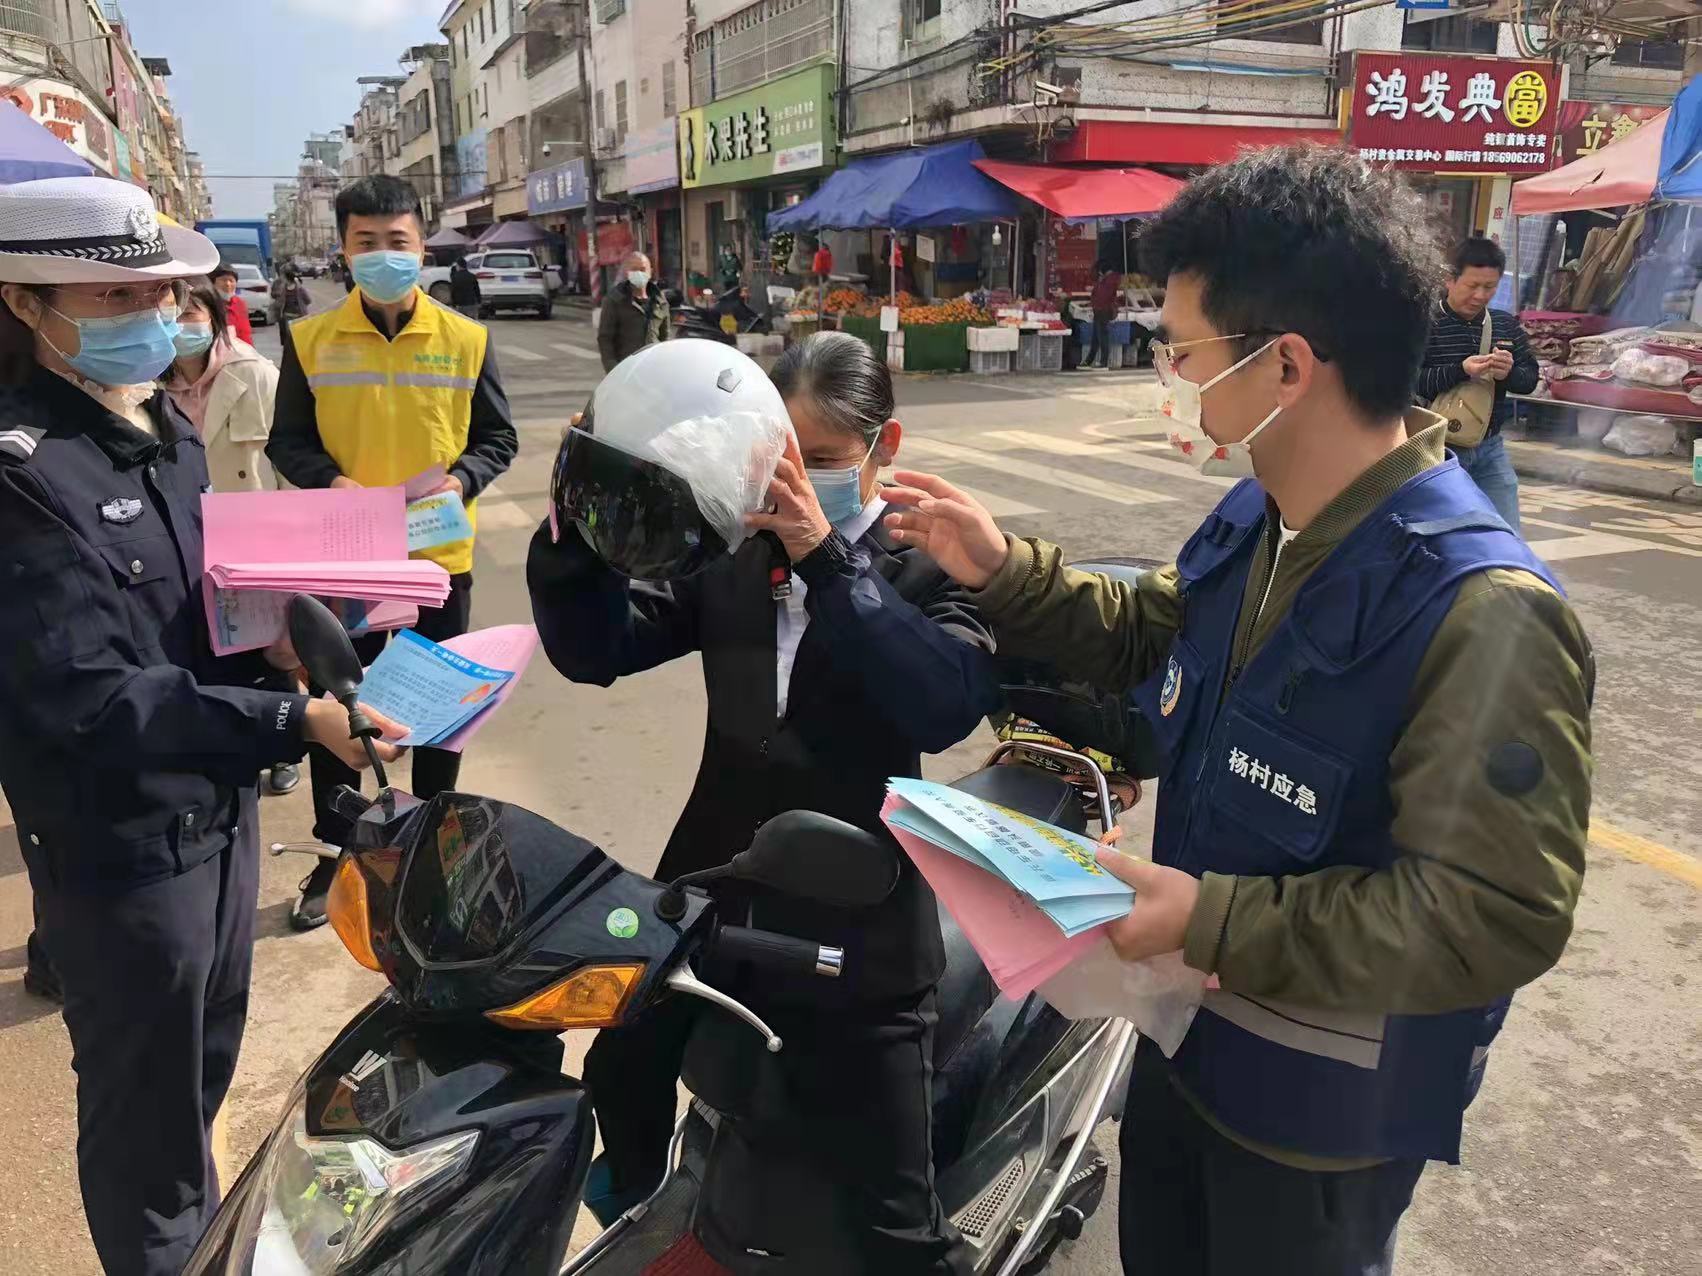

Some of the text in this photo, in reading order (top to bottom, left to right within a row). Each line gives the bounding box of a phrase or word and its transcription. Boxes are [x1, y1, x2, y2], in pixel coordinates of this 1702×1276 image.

[1365, 68, 1548, 128] 鸿发典當
[704, 106, 769, 165] 水果先生
[276, 700, 291, 730] POLICE
[1228, 746, 1318, 815] 杨村应急
